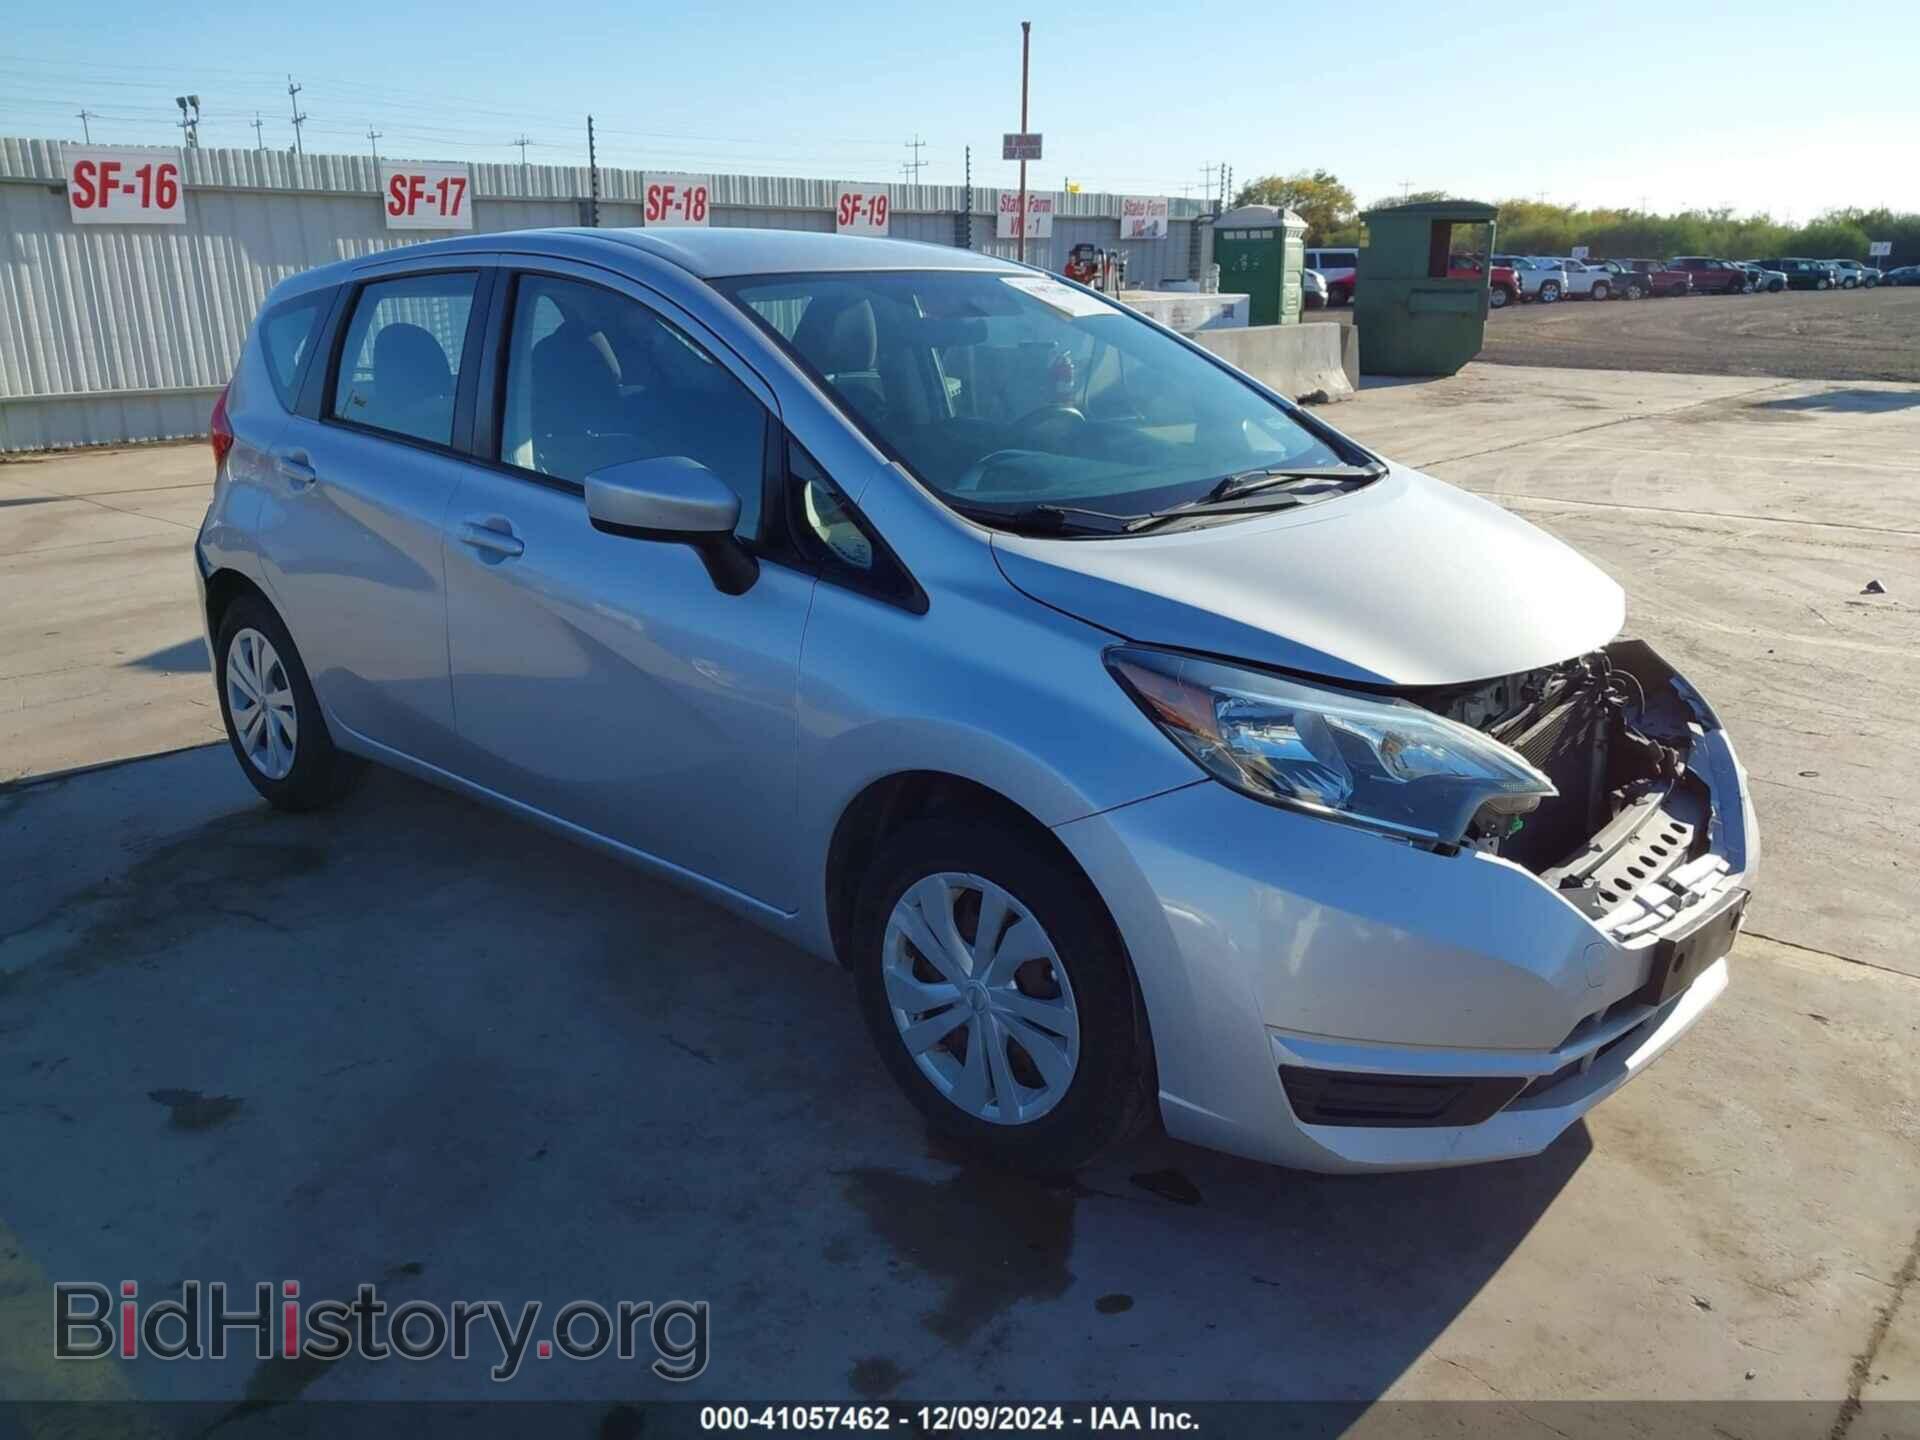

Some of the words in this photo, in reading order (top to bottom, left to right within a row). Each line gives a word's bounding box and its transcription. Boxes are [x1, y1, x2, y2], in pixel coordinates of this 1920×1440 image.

[73, 160, 178, 210] SF-16
[387, 174, 467, 216] SF-17
[646, 184, 707, 222] SF-18
[839, 193, 888, 226] SF-19
[1027, 194, 1051, 213] Farm
[1035, 216, 1041, 235] 1
